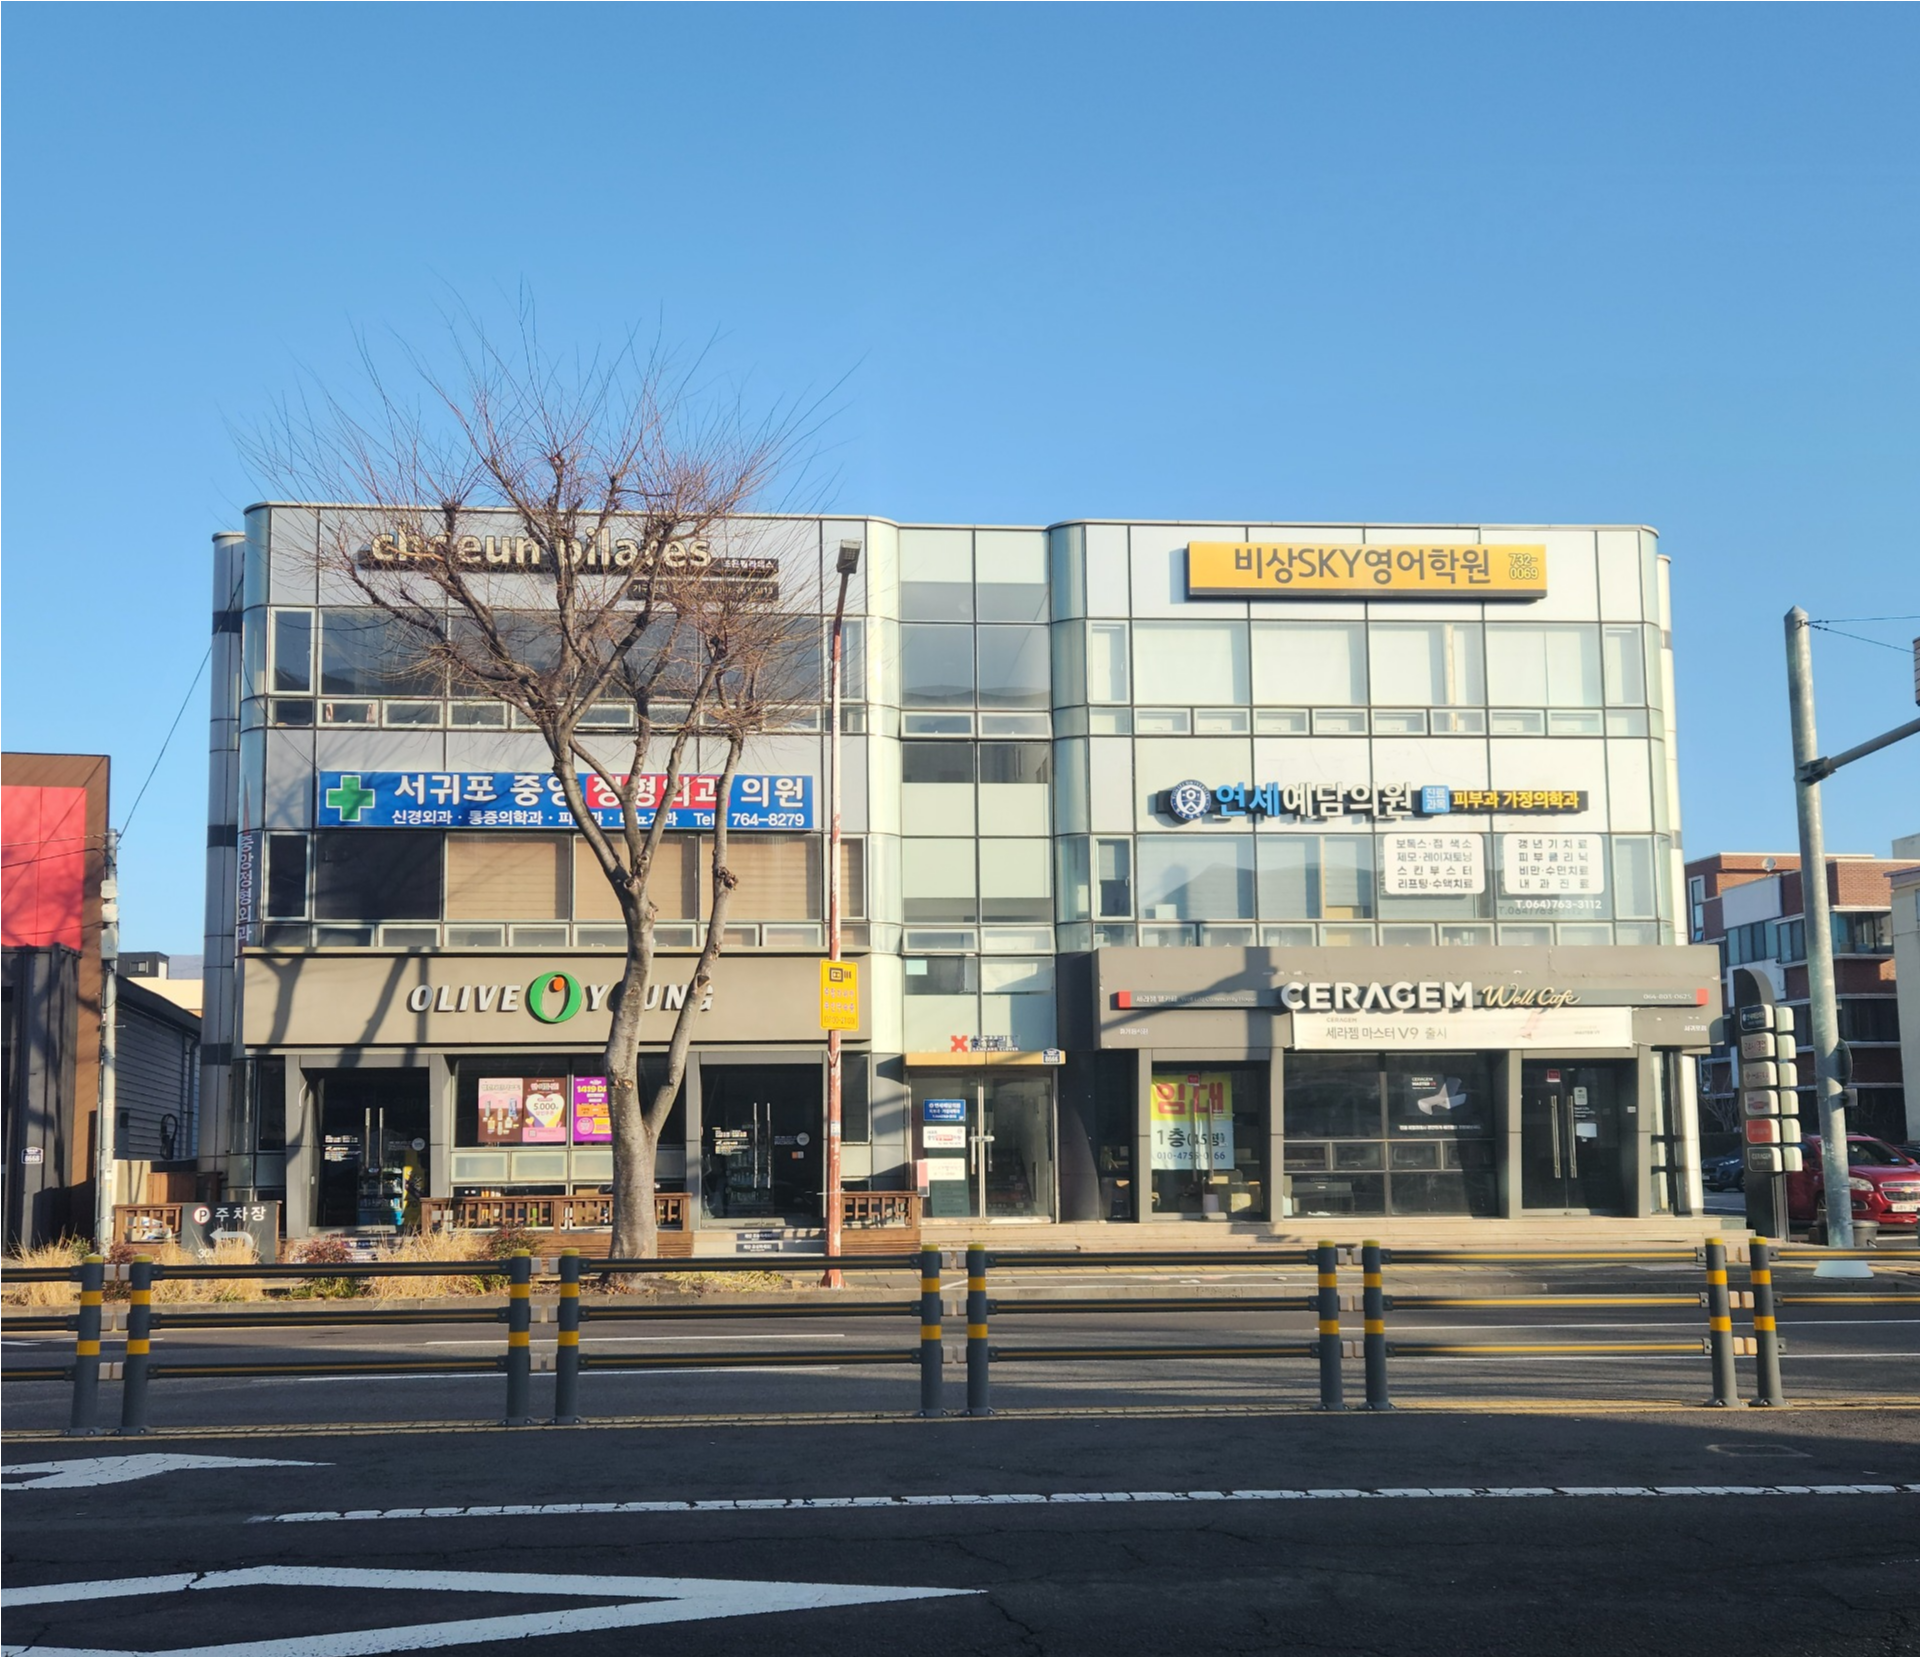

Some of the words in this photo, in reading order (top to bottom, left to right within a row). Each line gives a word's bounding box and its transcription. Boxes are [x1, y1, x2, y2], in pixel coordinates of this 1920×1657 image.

[1234, 547, 1491, 585] 비상SKY영어학원
[1508, 553, 1539, 566] 732-
[1509, 567, 1539, 580] 0069
[394, 774, 498, 806] 서귀포
[740, 777, 804, 808] 의원
[1215, 781, 1413, 818] 연세예담의원
[1453, 790, 1500, 808] 피부과
[1503, 790, 1580, 809] 가정의학과
[391, 809, 453, 826] 신경외과
[468, 809, 543, 826] 통증의학과
[731, 812, 805, 827] 764-8279
[1515, 899, 1603, 910] T.064)763-3112
[410, 984, 521, 1012] OLIVE
[588, 984, 714, 1012] YUNG
[1281, 981, 1474, 1010] CERAGEM
[1482, 983, 1536, 1007] Well
[1538, 986, 1582, 1010] Cafe
[1326, 1027, 1359, 1039] 세라젬
[1362, 1027, 1395, 1040] 마스터
[1398, 1027, 1419, 1039] V9
[1425, 1026, 1448, 1040] 출시
[1156, 1082, 1224, 1115] 임대
[215, 1205, 267, 1222] 주차장
